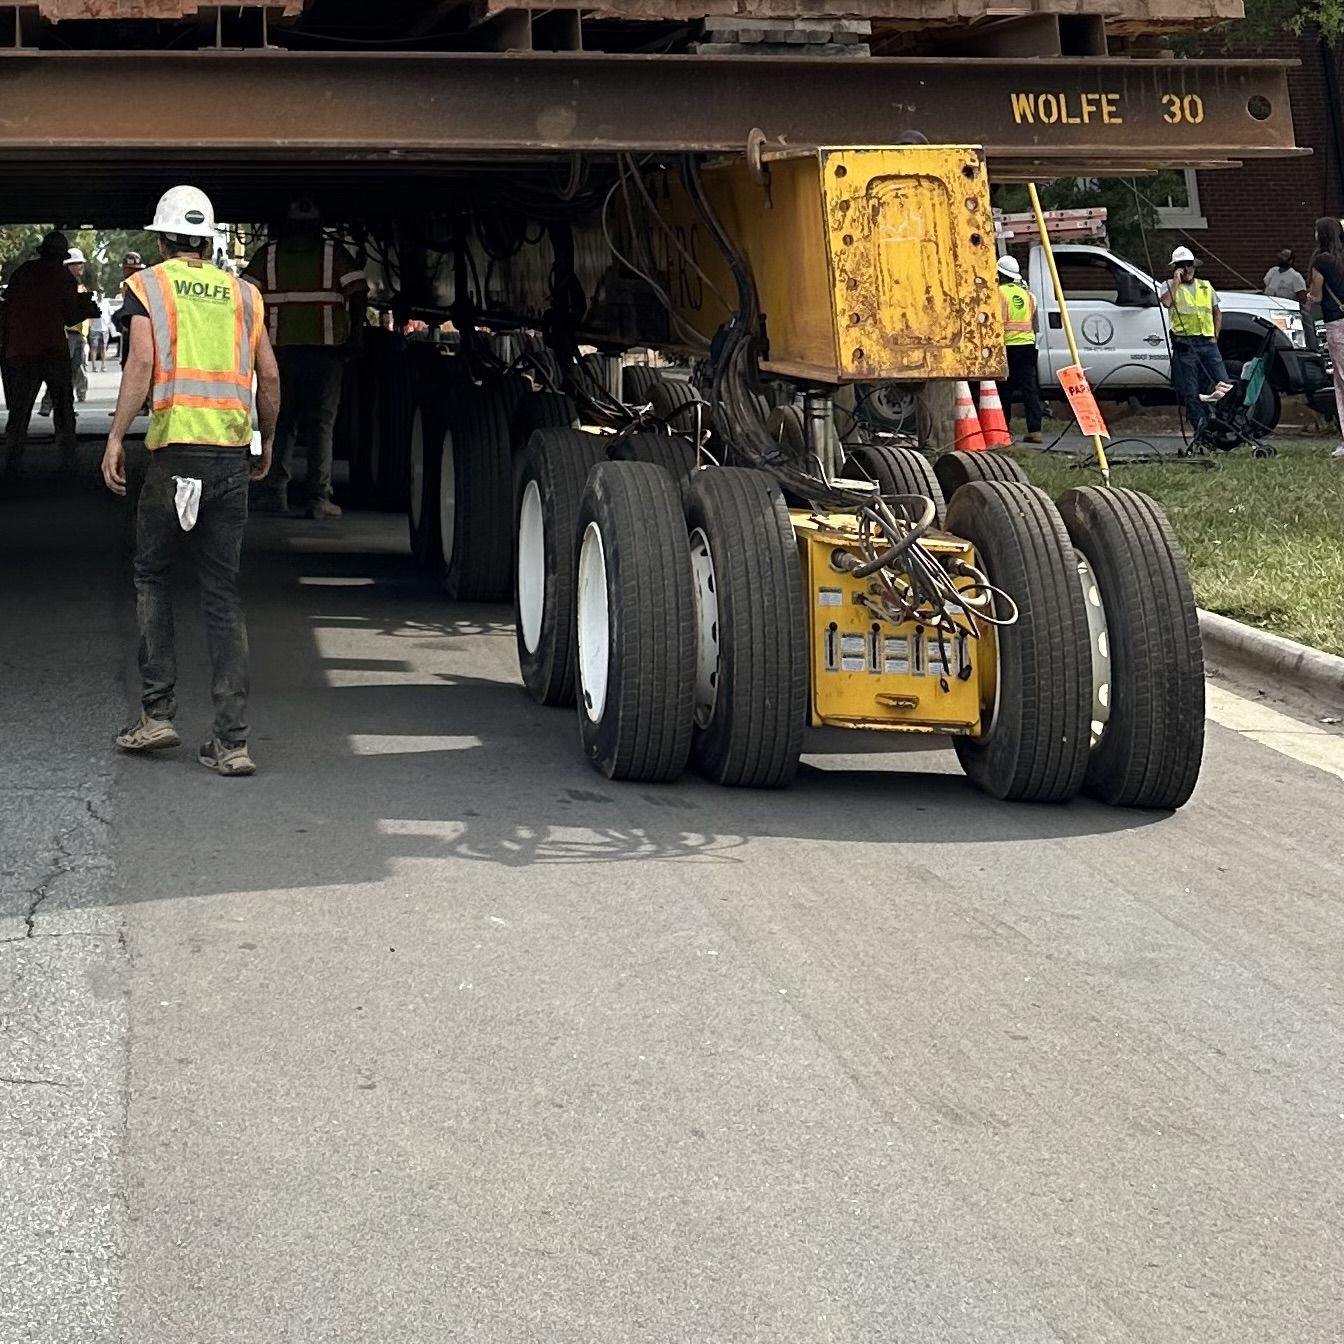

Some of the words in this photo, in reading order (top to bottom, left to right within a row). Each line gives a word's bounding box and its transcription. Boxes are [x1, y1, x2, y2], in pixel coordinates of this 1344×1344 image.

[1010, 92, 1124, 125] WOLFE
[1161, 93, 1205, 125] 30
[174, 279, 231, 299] WOLFE
